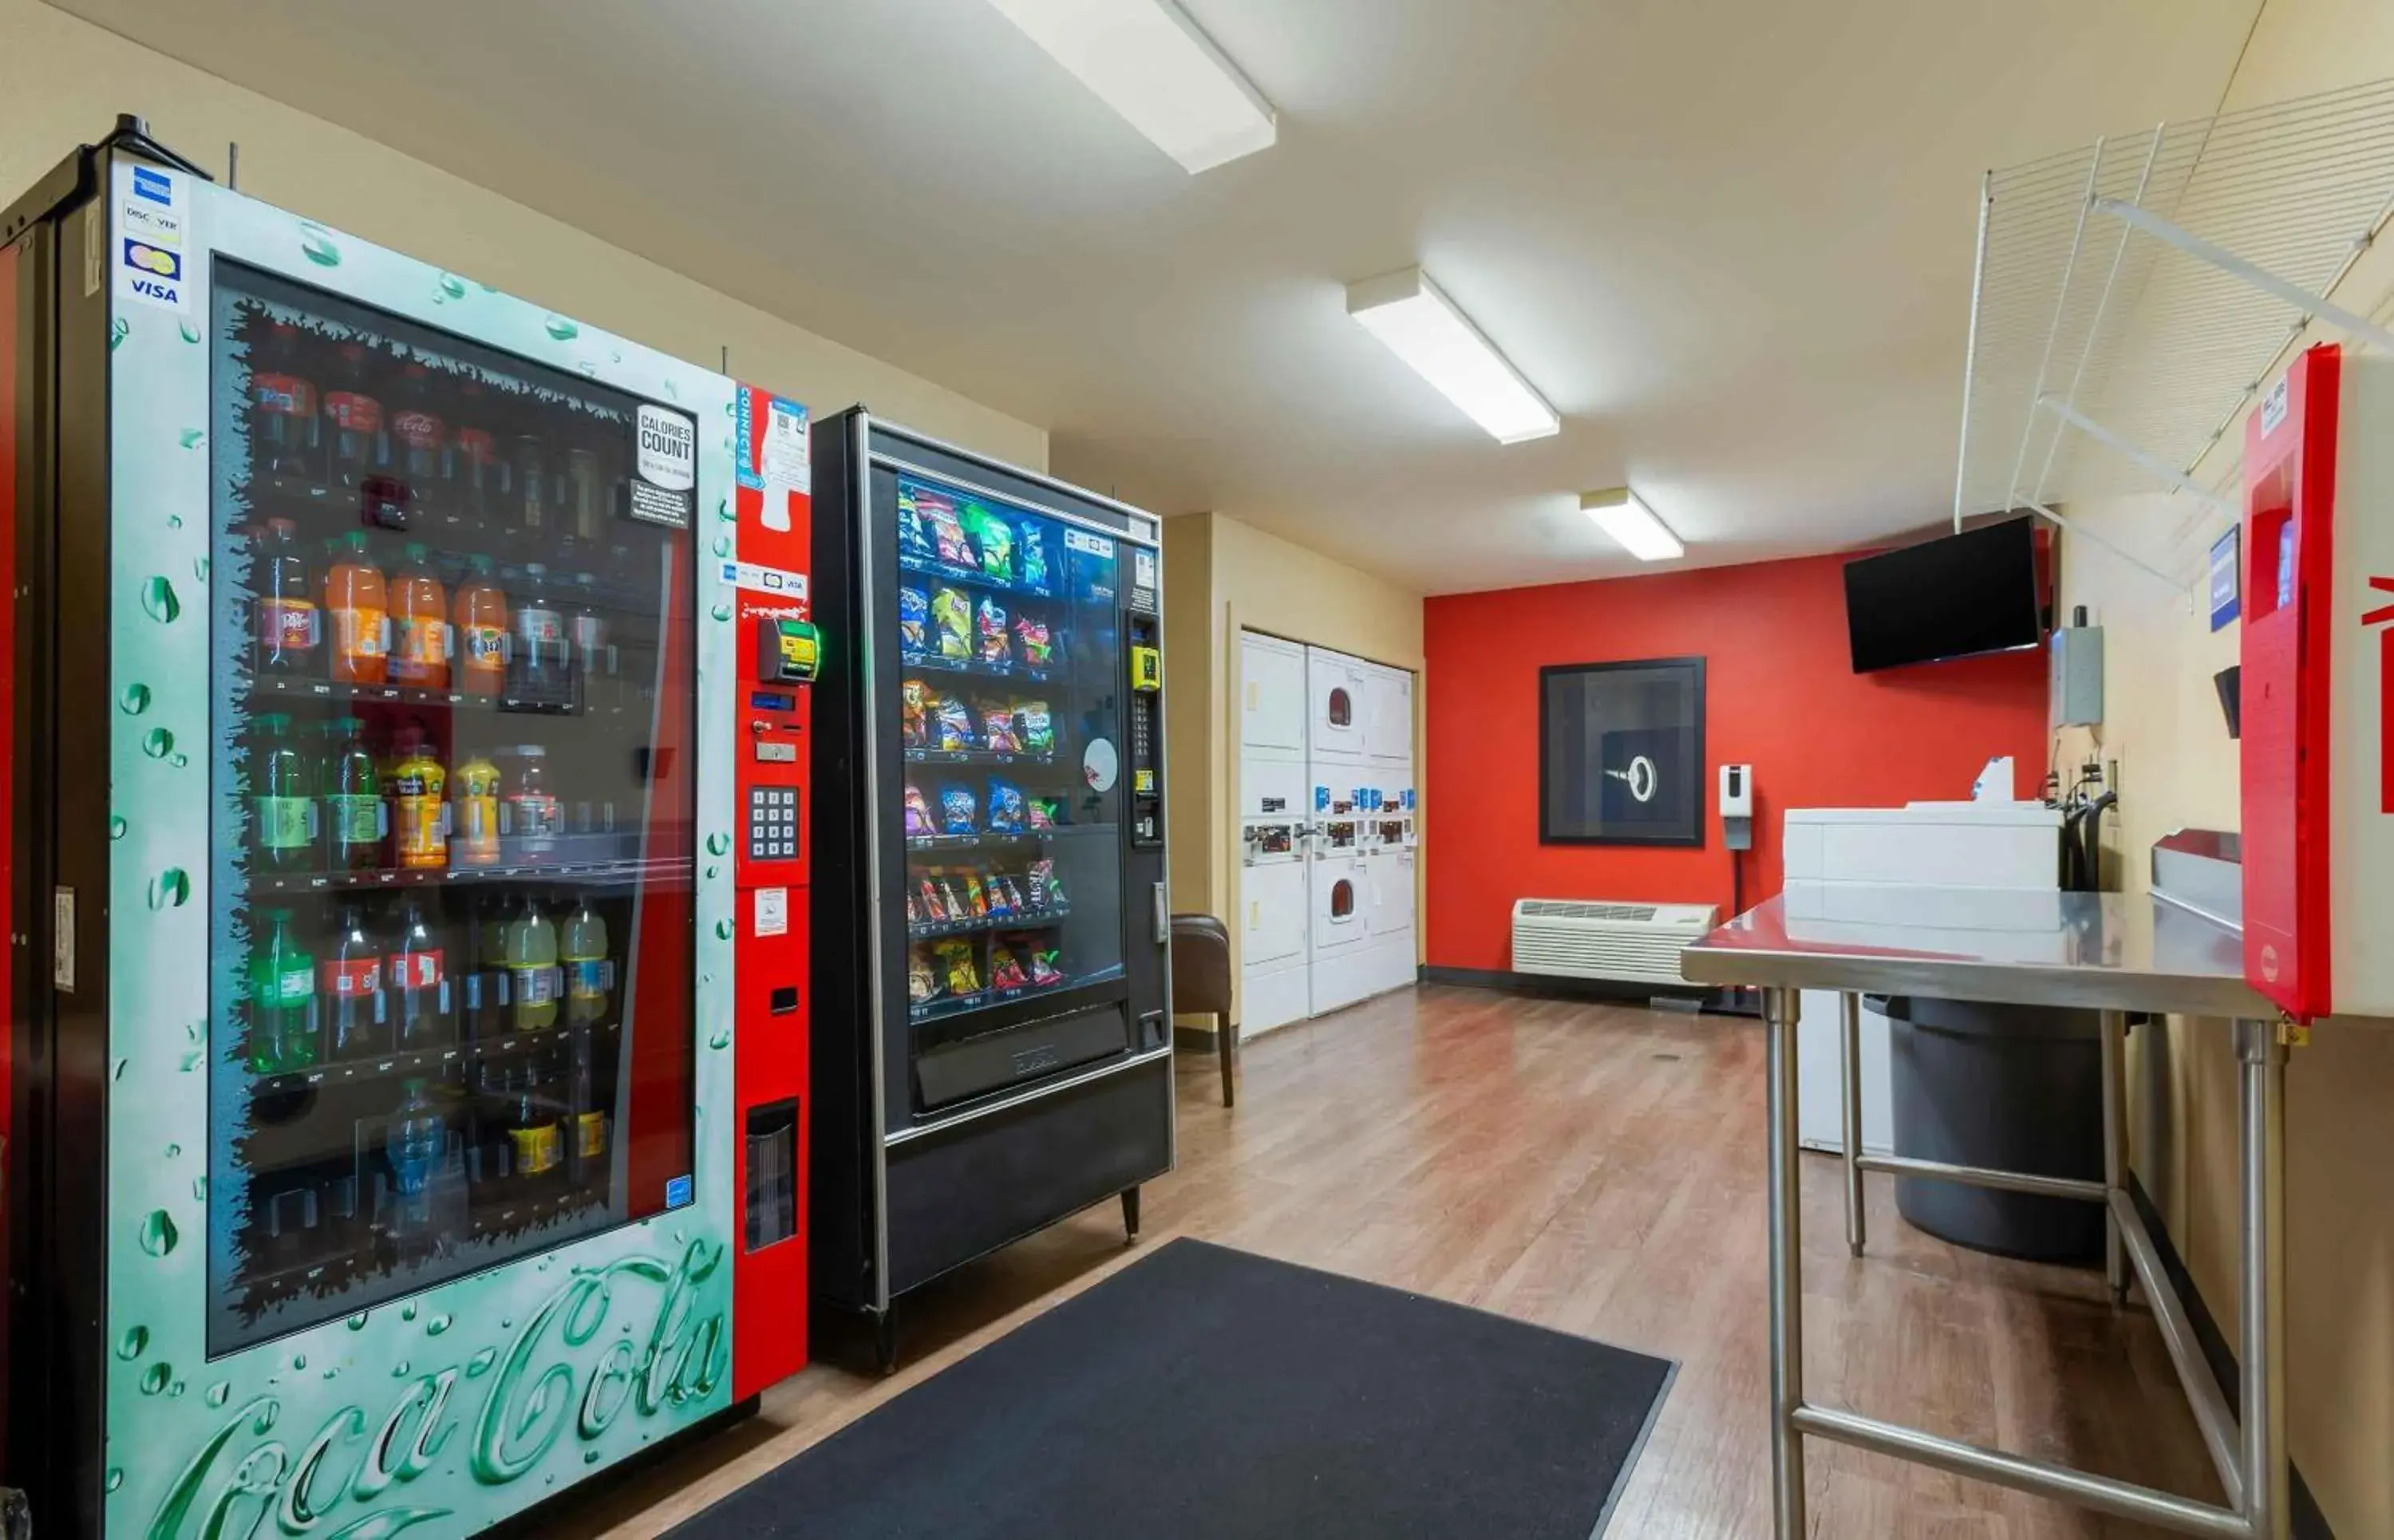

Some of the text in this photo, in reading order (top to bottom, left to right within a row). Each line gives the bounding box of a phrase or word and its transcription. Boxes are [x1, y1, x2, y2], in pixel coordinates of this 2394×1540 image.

[127, 207, 177, 230] DISCVER
[132, 280, 178, 303] VISA
[641, 414, 691, 441] CALORIES
[739, 386, 752, 459] CONNECT
[641, 430, 691, 460] COUNT
